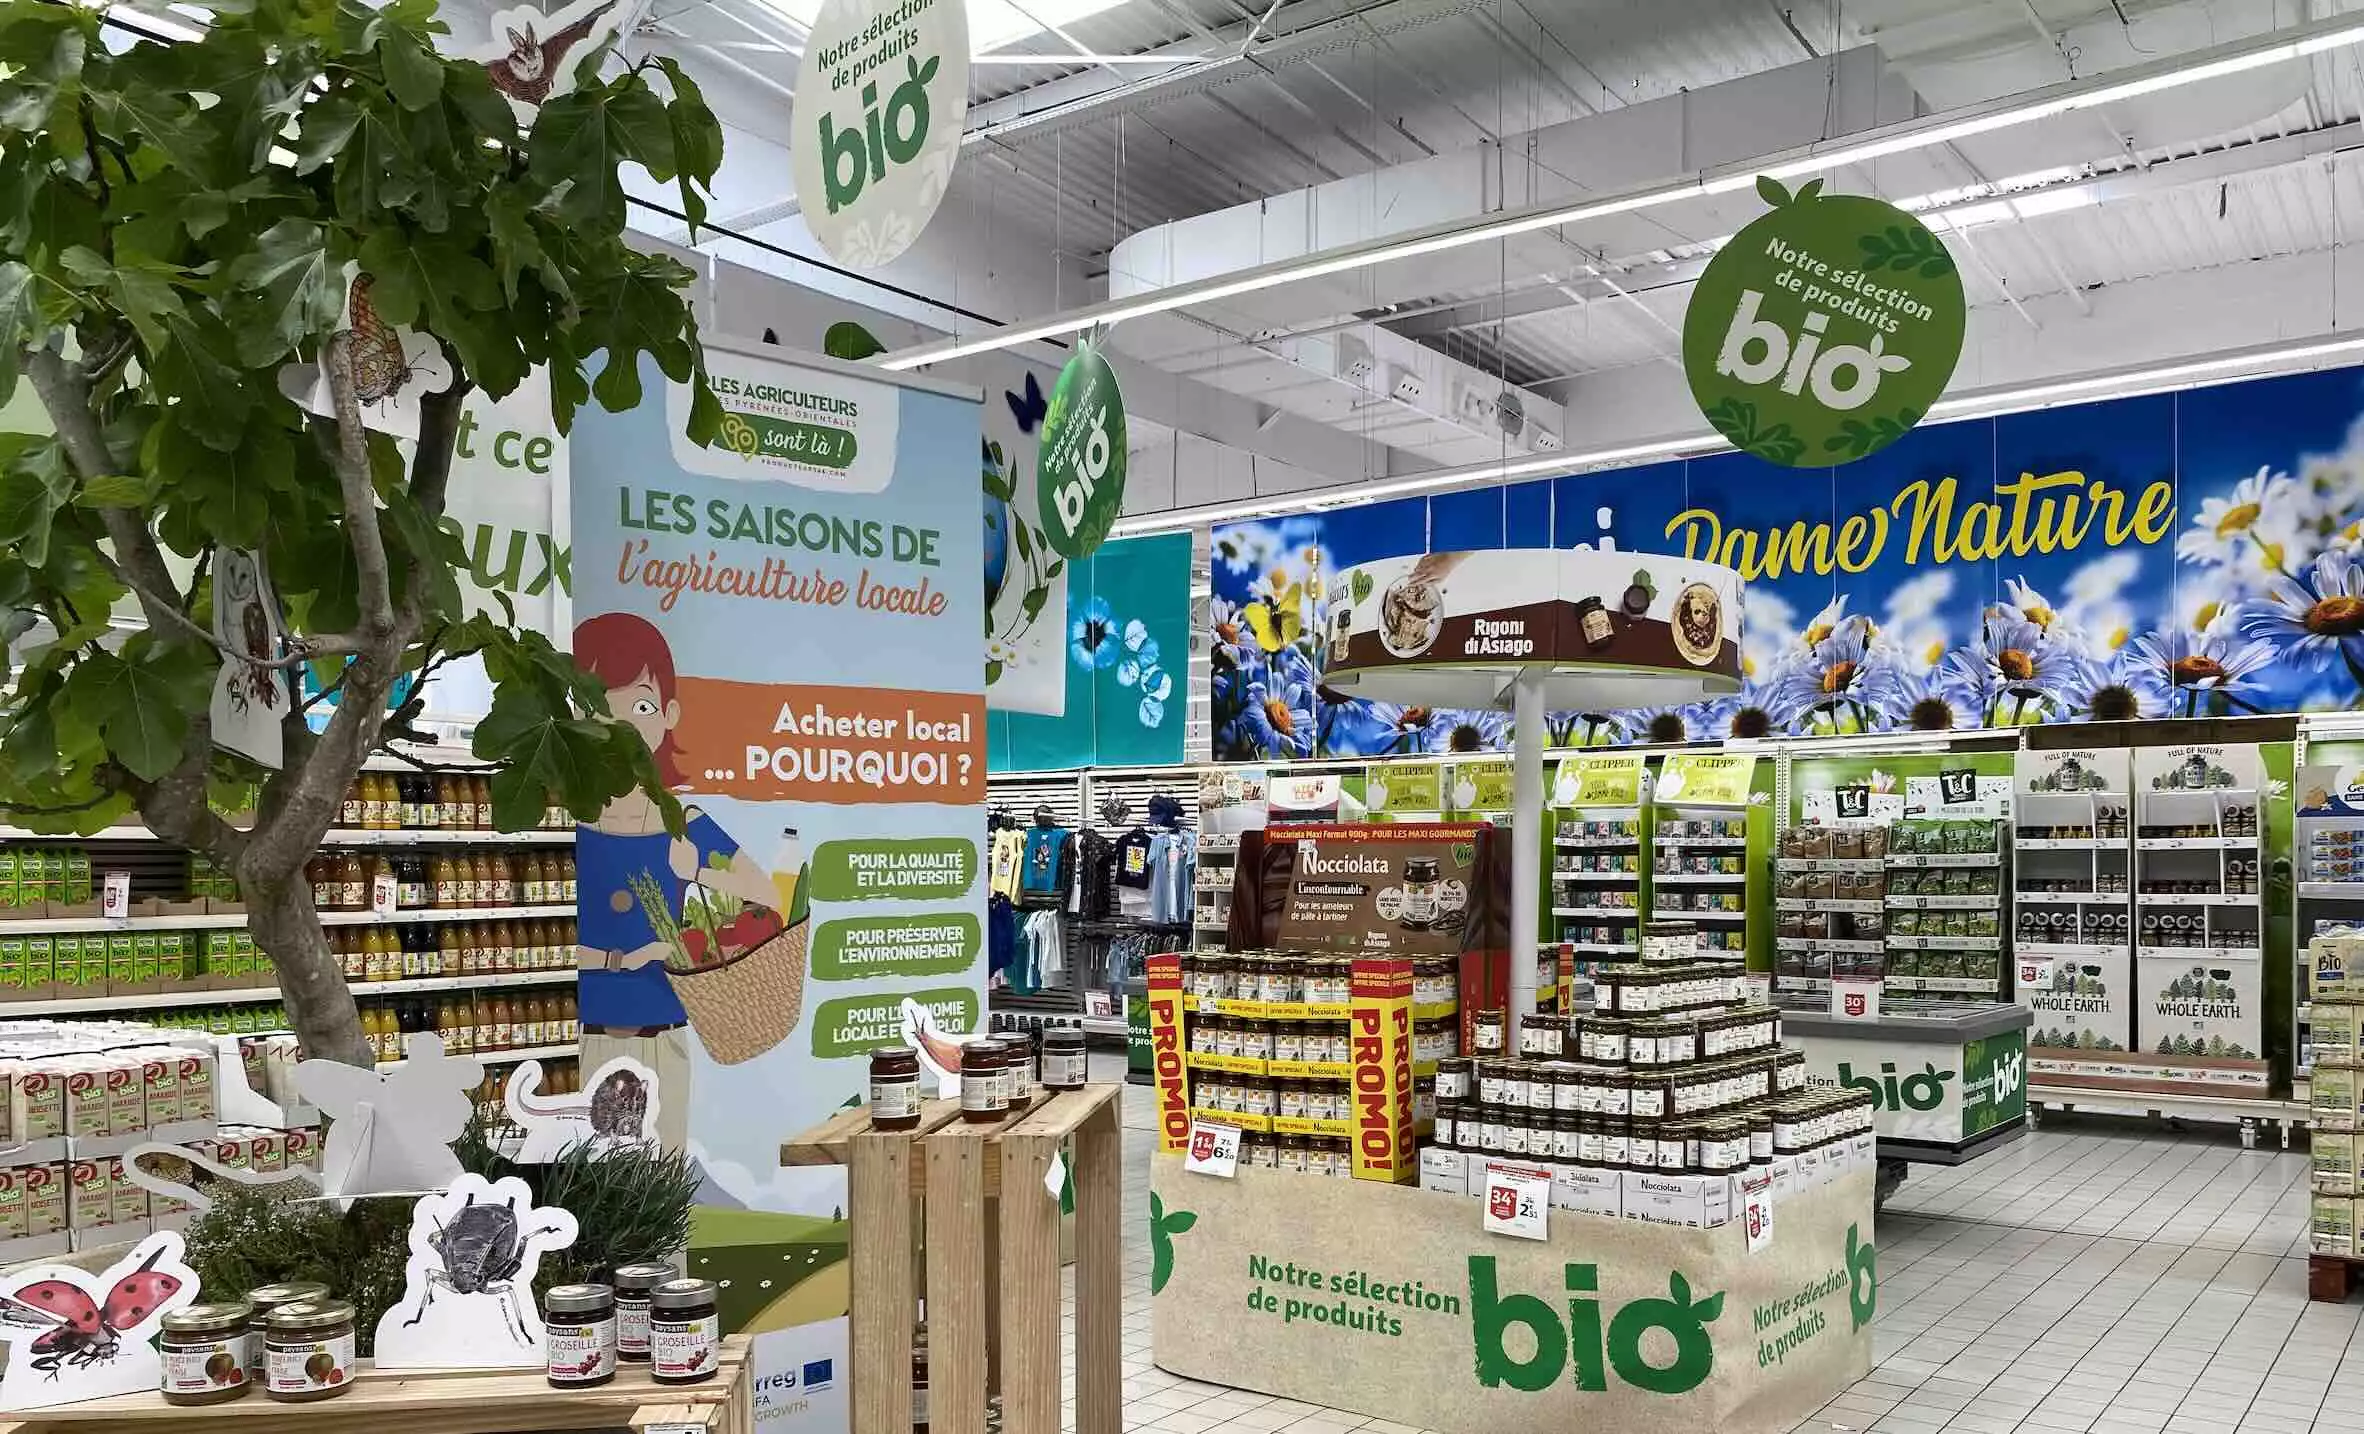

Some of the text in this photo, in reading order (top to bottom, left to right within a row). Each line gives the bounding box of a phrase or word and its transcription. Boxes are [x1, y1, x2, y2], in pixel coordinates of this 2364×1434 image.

[817, 0, 937, 72] Notre sélection
[832, 26, 919, 91] de produits
[818, 79, 931, 216] bio
[1765, 236, 1934, 322] Notre sélection
[1775, 269, 1901, 334] de produits
[1716, 288, 1882, 411] bio
[711, 375, 858, 417] LES AGRICULTEURS
[764, 428, 807, 451] sont
[811, 431, 831, 456] là
[1052, 427, 1110, 539] bio
[618, 486, 942, 567] LES SAISONS DE
[1664, 506, 1890, 583] Dame
[1890, 470, 2178, 566] Nature
[616, 538, 949, 617] l'agriculture locale
[1474, 618, 1526, 639] Rigoni
[1479, 636, 1534, 657] Asiago
[772, 701, 972, 743] Acheter local
[745, 744, 949, 790] POURQUOI
[956, 753, 973, 787] ?
[848, 849, 964, 870] POUR LA QUALITÉ
[857, 871, 877, 887] ET
[877, 871, 897, 886] LA
[1301, 849, 1390, 876] Nocciolata
[838, 943, 965, 964] L'ENVIRONNEMENT
[846, 924, 965, 946] POUR PRÉSERVER
[847, 1008, 887, 1025] POUR
[2031, 997, 2072, 1012] WHOLE
[2156, 1002, 2198, 1017] WHOLE
[832, 1022, 887, 1044] LOCALE
[1150, 999, 1190, 1150] PROMO!
[1351, 1008, 1393, 1170] PROMO!
[1392, 1006, 1416, 1170] PROMO!
[1838, 1062, 1945, 1112] bio
[1993, 1055, 2020, 1105] bio
[1641, 1178, 1682, 1193] Nocciolata
[1249, 1254, 1460, 1316] Notre sélection
[1753, 1267, 1849, 1335] Notre sélection
[1247, 1286, 1403, 1337] de produits
[1468, 1254, 1715, 1396] bio
[1757, 1310, 1826, 1368] de produits
